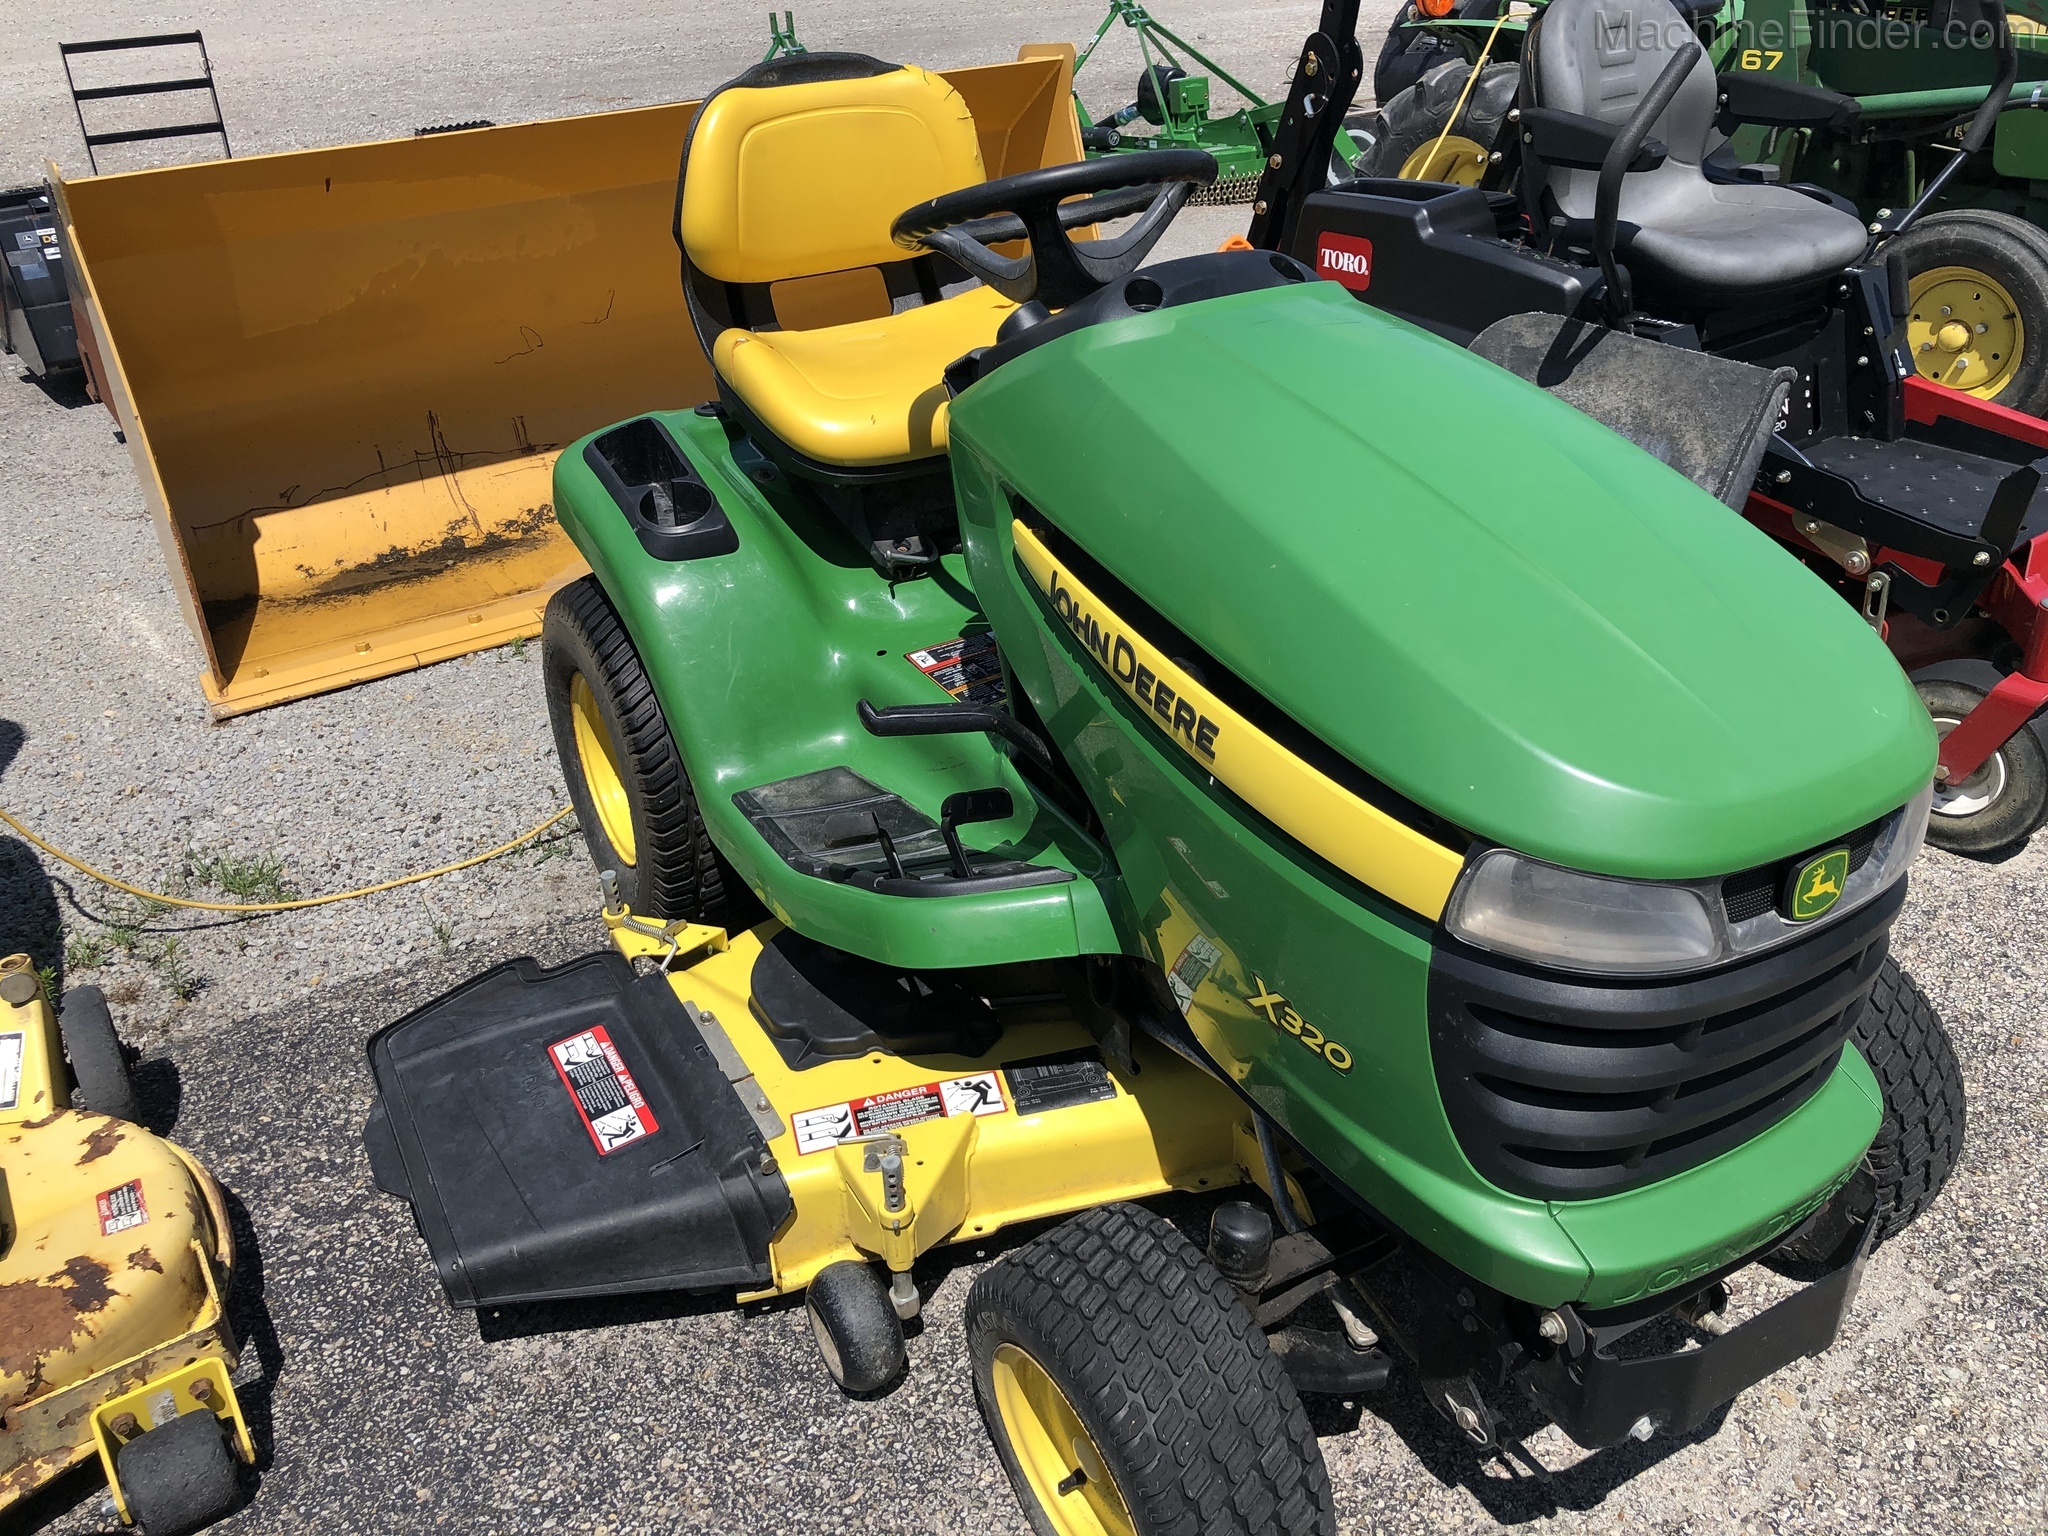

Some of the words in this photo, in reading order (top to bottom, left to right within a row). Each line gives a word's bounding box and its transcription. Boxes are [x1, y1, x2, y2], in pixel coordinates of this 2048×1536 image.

[1321, 247, 1368, 275] TORO
[1043, 570, 1111, 665] JOHN
[1112, 634, 1220, 760] DEERE
[1245, 971, 1353, 1072] X320
[603, 1044, 625, 1073] DANGER
[621, 1076, 645, 1109] PELIGRO
[876, 1086, 928, 1103] DANGER
